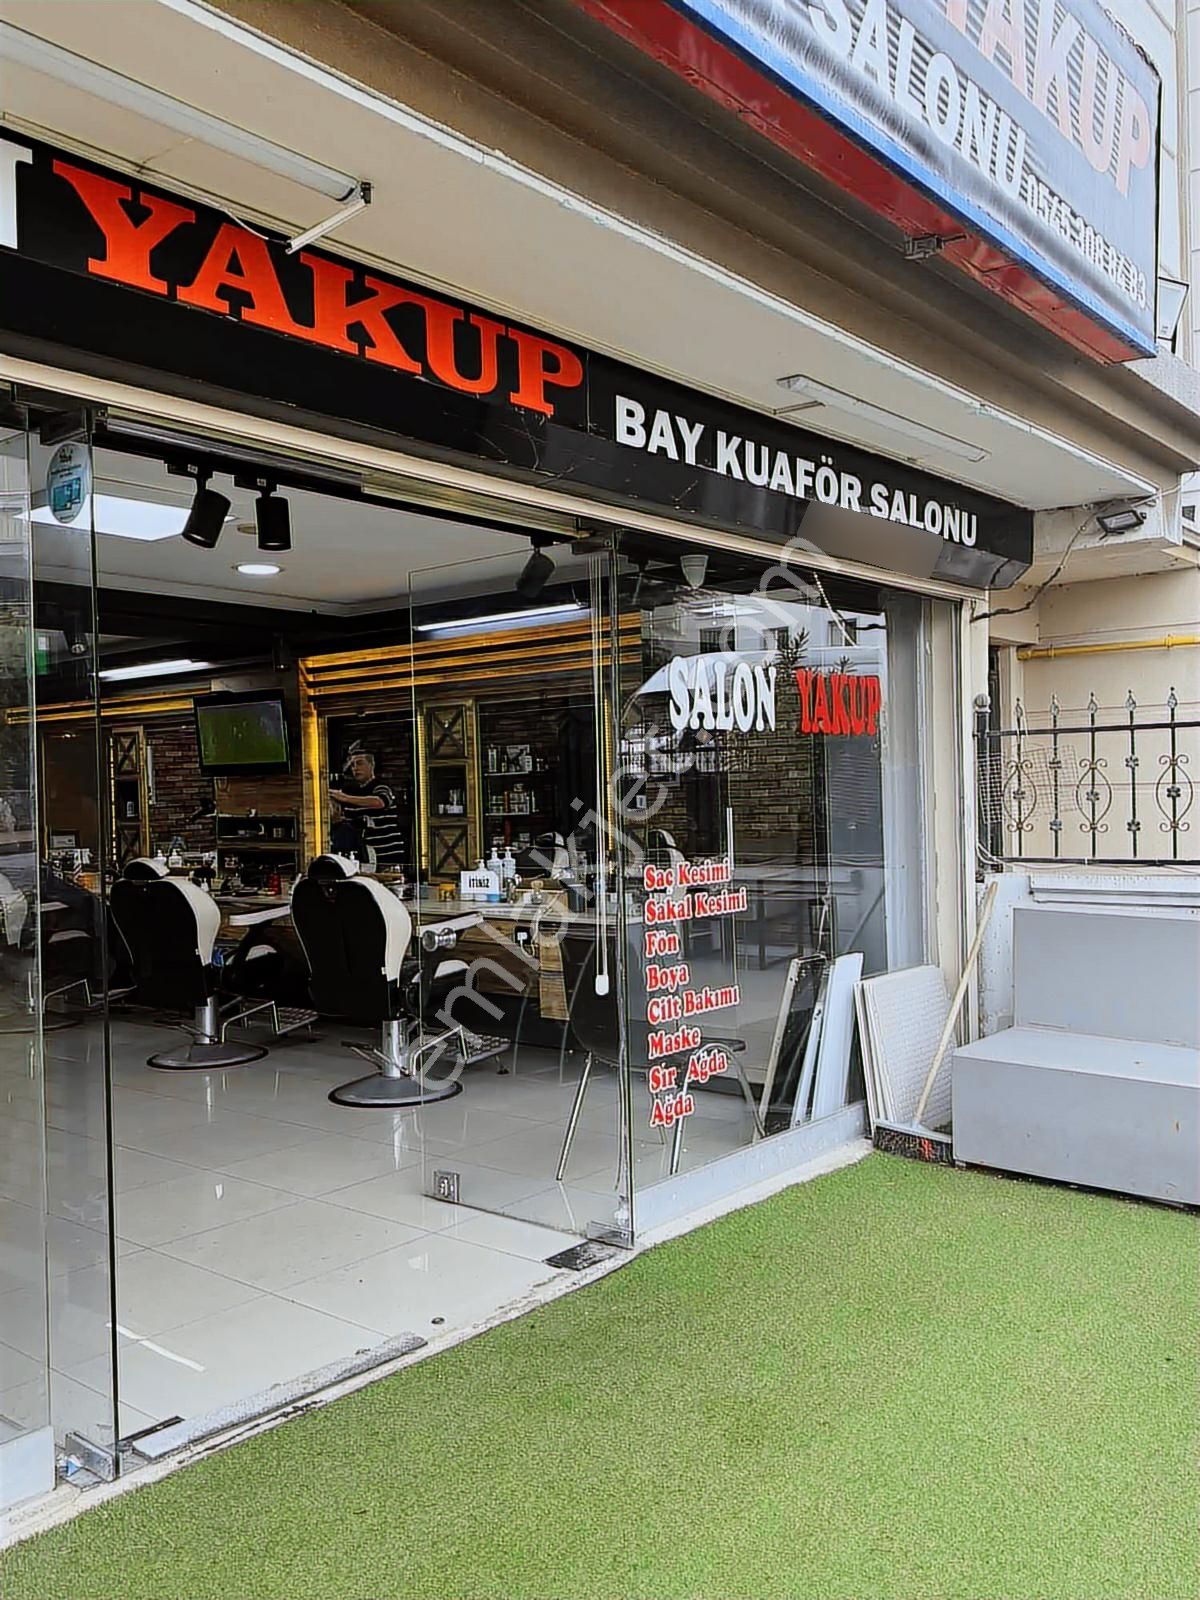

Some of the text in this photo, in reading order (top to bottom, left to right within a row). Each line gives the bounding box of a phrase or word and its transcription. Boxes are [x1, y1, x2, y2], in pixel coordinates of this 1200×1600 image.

[944, 0, 1150, 197] AKUP
[53, 159, 584, 417] YAKUP
[614, 395, 978, 547] BAY KUAFÖR SALONU
[669, 656, 882, 736] SALON YAKUP
[644, 858, 731, 894] Saç Kesimi
[645, 887, 747, 925] Sakal Kesimi
[645, 930, 680, 959] Fön
[646, 964, 690, 993] Boya
[648, 985, 741, 1025] Cilt Bakımı
[648, 1025, 701, 1060] Maske
[687, 1050, 728, 1084] Ağda
[650, 1091, 695, 1128] Ağda
